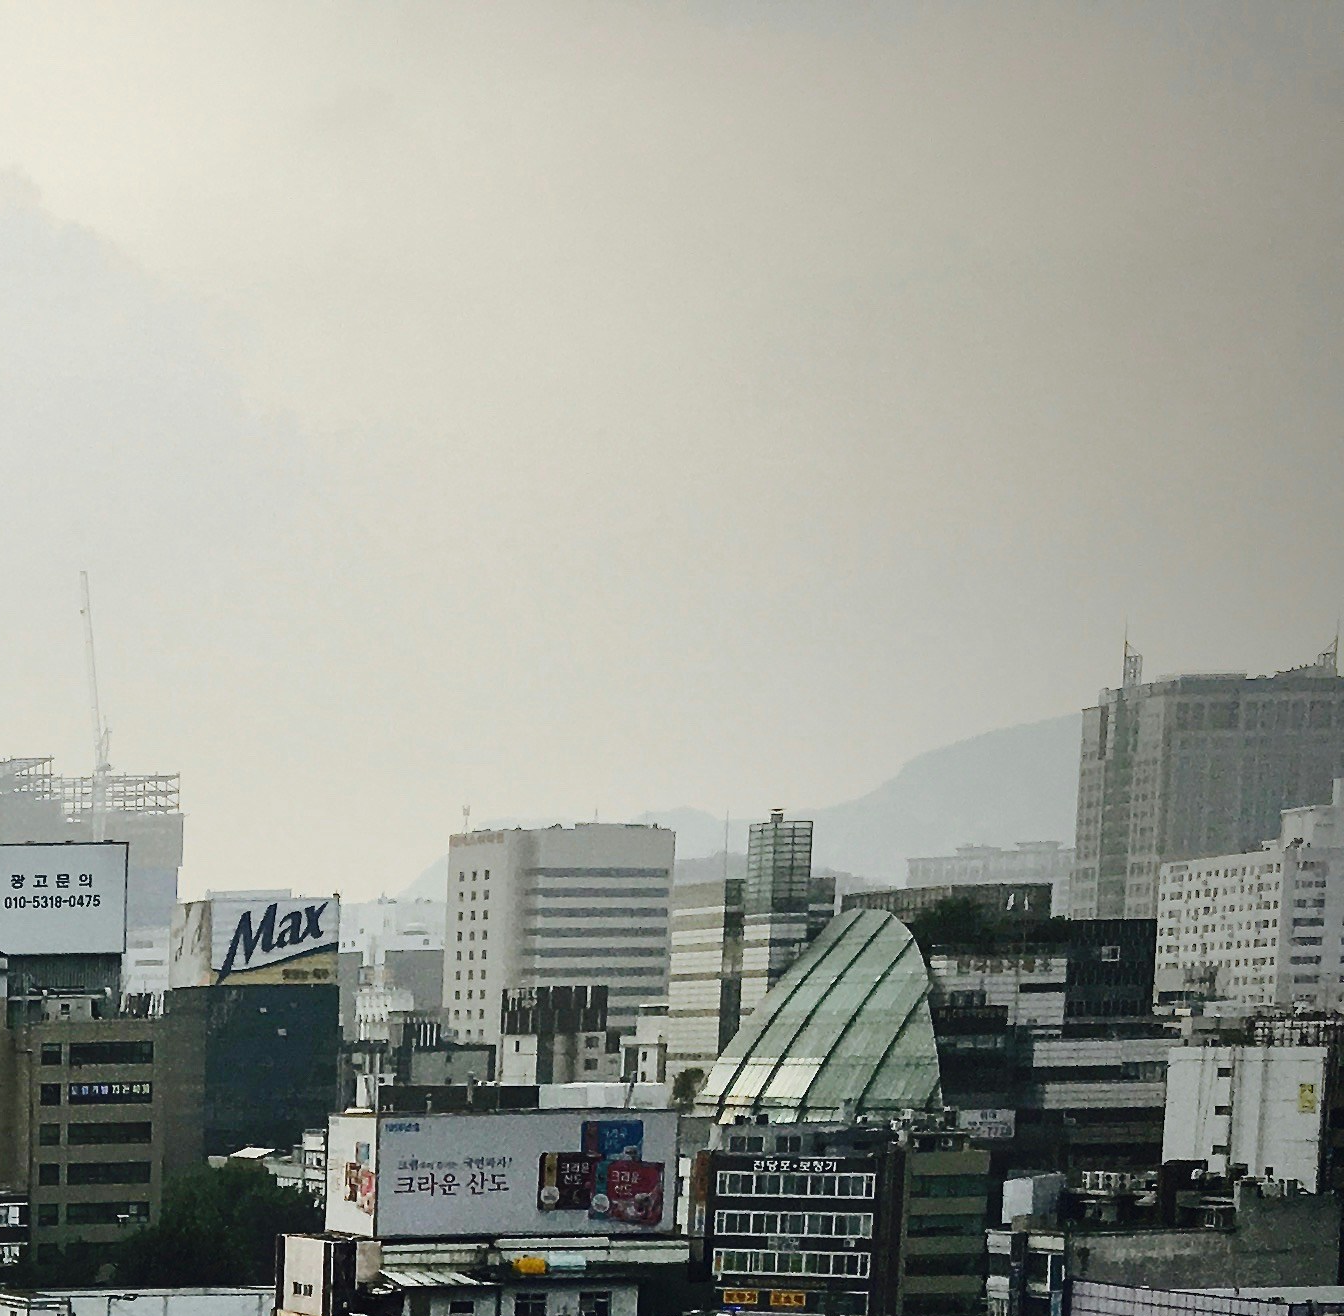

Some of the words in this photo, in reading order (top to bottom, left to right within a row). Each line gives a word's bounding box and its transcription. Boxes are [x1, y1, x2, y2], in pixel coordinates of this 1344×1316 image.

[10, 873, 93, 890] 광고문의
[4, 894, 102, 909] 010-5318-0475
[215, 901, 329, 985] Max
[393, 1172, 461, 1197] 크라운
[465, 1171, 510, 1196] 산도
